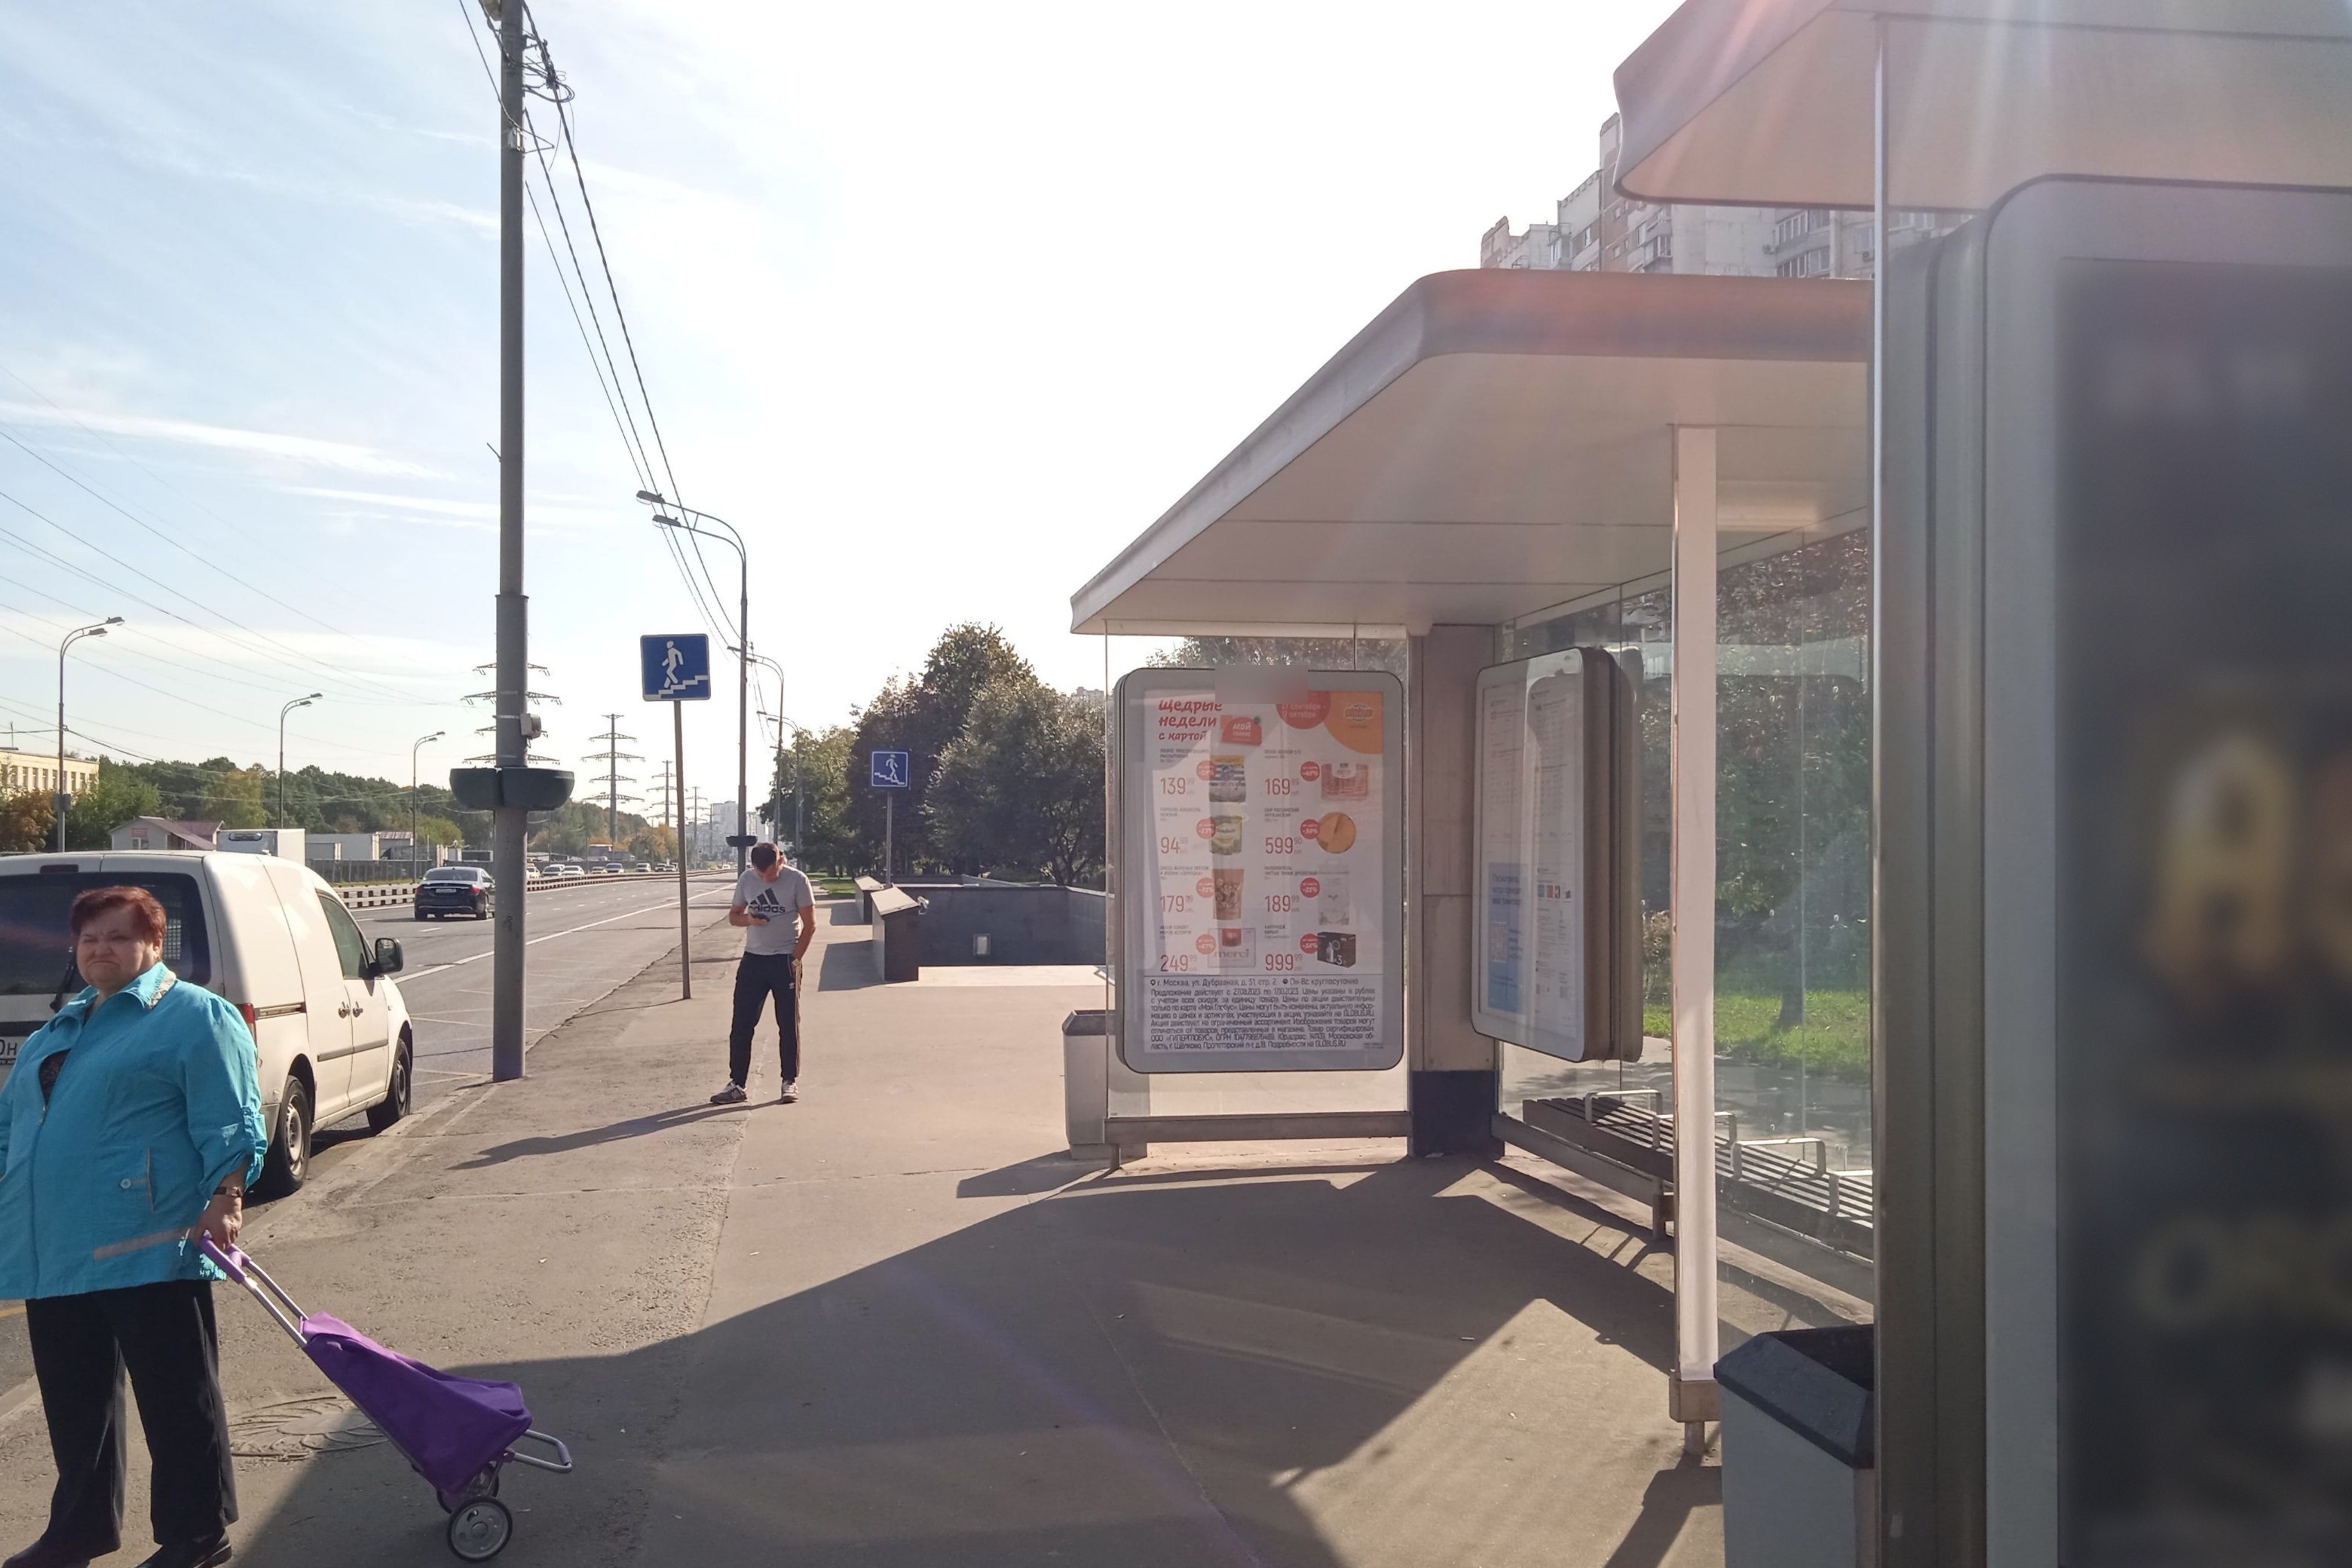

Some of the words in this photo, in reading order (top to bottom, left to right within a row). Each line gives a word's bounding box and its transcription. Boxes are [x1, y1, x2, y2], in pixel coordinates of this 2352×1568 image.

[1168, 730, 1208, 742] картой
[1160, 777, 1186, 795] 139
[1265, 778, 1291, 795] 169
[1160, 837, 1180, 854] 94
[1265, 837, 1293, 854] 599
[1160, 896, 1184, 912] 179
[1265, 896, 1291, 912] 189
[1214, 949, 1249, 958] merci
[1160, 954, 1188, 972] 249
[1265, 954, 1294, 971] 999
[1312, 978, 1358, 987] круглосуточно
